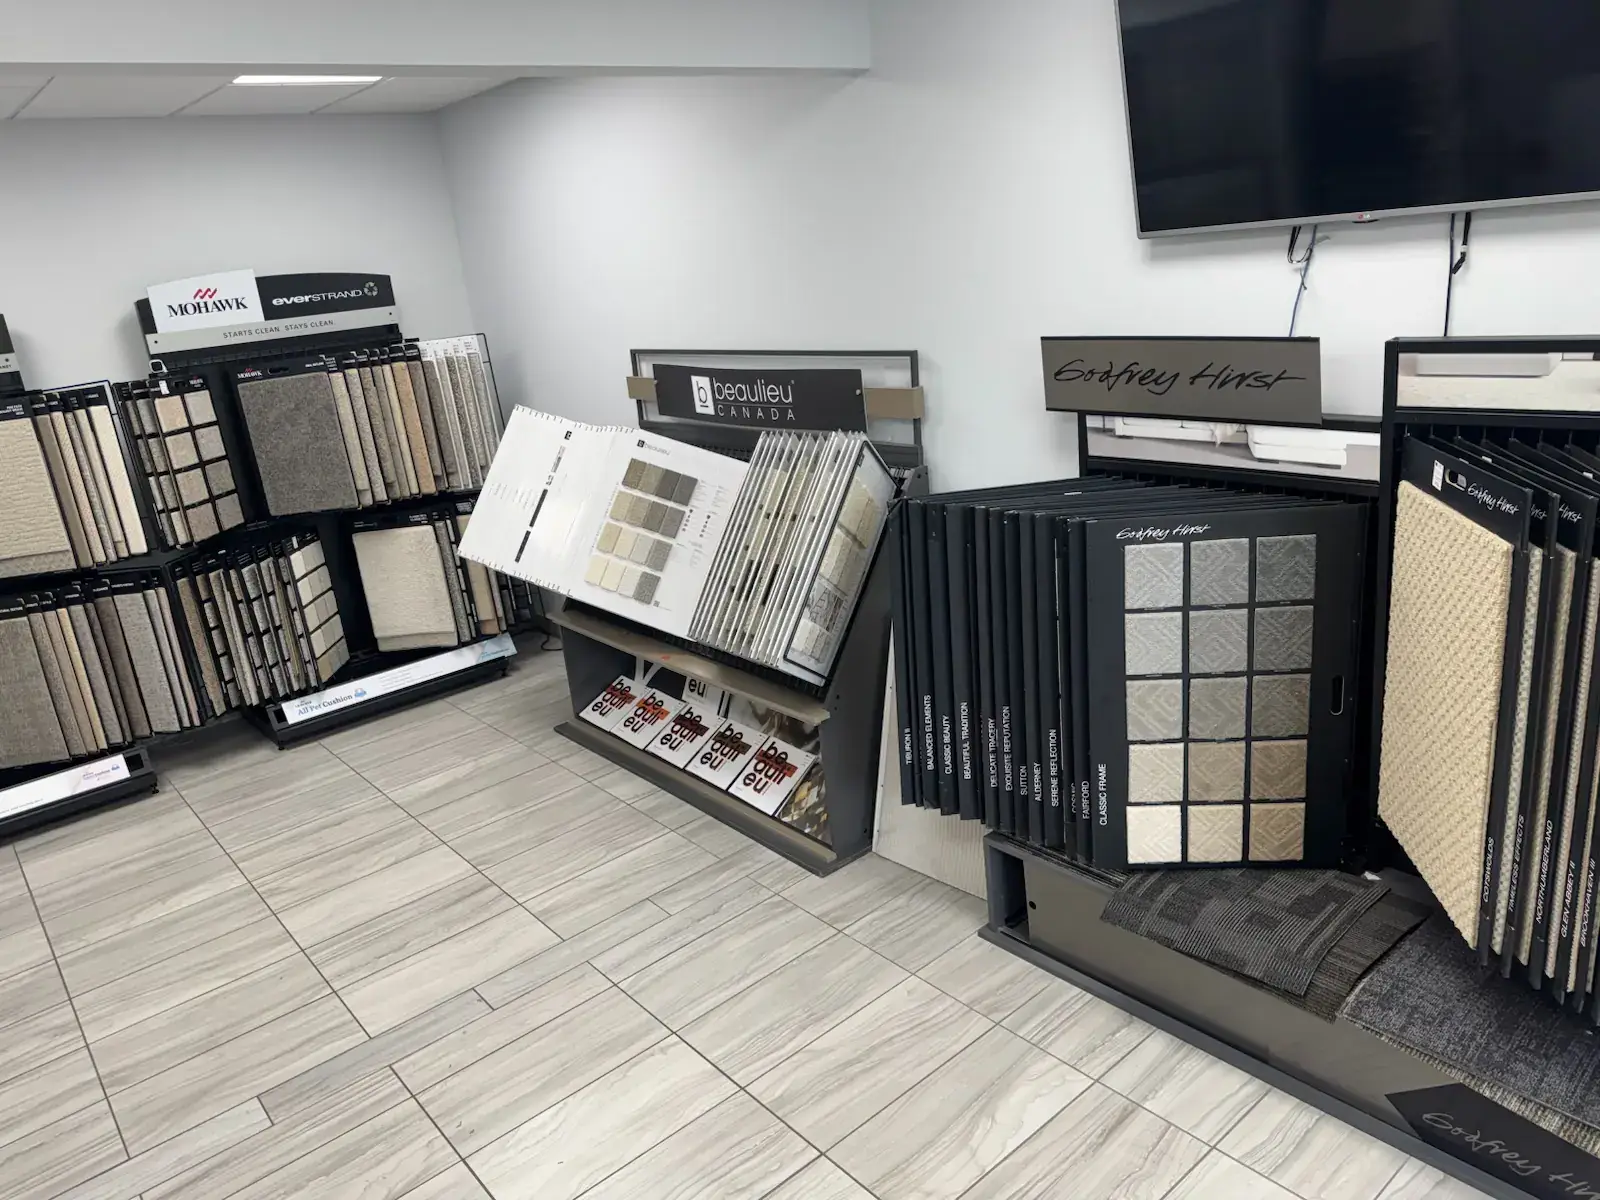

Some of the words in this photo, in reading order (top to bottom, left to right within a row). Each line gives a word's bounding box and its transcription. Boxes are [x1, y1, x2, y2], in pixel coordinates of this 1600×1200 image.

[167, 294, 249, 318] MOHAWK
[271, 288, 364, 307] everSTRAND
[222, 327, 254, 339] STARTS
[254, 324, 280, 336] CLEAN
[284, 321, 310, 333] STAYS
[713, 377, 795, 405] beaulieu
[1053, 358, 1181, 396] Godfrey
[1189, 361, 1307, 392] Hirst
[717, 404, 796, 421] CANADA
[1115, 526, 1170, 541] Godfrey
[1171, 523, 1212, 537] Hirst
[322, 693, 353, 708] Cushion
[612, 678, 632, 695] be
[643, 692, 664, 710] be
[591, 700, 612, 717] eu
[680, 706, 703, 725] be
[923, 694, 932, 732] ELEMENTS
[960, 702, 969, 740] TRADITION
[623, 716, 642, 733] eu
[720, 723, 744, 744] be
[942, 715, 951, 744] BEAUTY
[987, 717, 996, 752] TRACERY
[1002, 705, 1011, 752] REPUTATION
[660, 733, 681, 751] eu
[763, 741, 789, 762] be
[925, 733, 934, 771] BALANCED
[1049, 729, 1058, 776] REFLECTION
[700, 750, 721, 770] eu
[943, 744, 952, 775] CLASSIC
[962, 741, 971, 780] BEAUTIFUL
[989, 753, 998, 788] DELICATE
[1005, 753, 1013, 792] EXQUISITE
[742, 772, 768, 794] eu
[1019, 765, 1028, 796] SUTTON
[1033, 761, 1042, 802] ALDERNEY
[1050, 777, 1059, 807] SERENE
[1098, 763, 1107, 791] FRAME
[1081, 780, 1090, 819] FAIRFORD
[1098, 792, 1107, 826] CLASSIC
[1482, 836, 1495, 903] COTSWOLDS
[1507, 862, 1519, 913] TIMELESS
[1513, 813, 1525, 862] EFFECTS
[1535, 819, 1553, 924] NORTHUMBERLAND
[1563, 870, 1576, 909] ABBEY
[1560, 908, 1570, 938] GLEN
[1580, 871, 1594, 948] BROOKHAVEN
[1421, 1112, 1542, 1176] Godfrey
